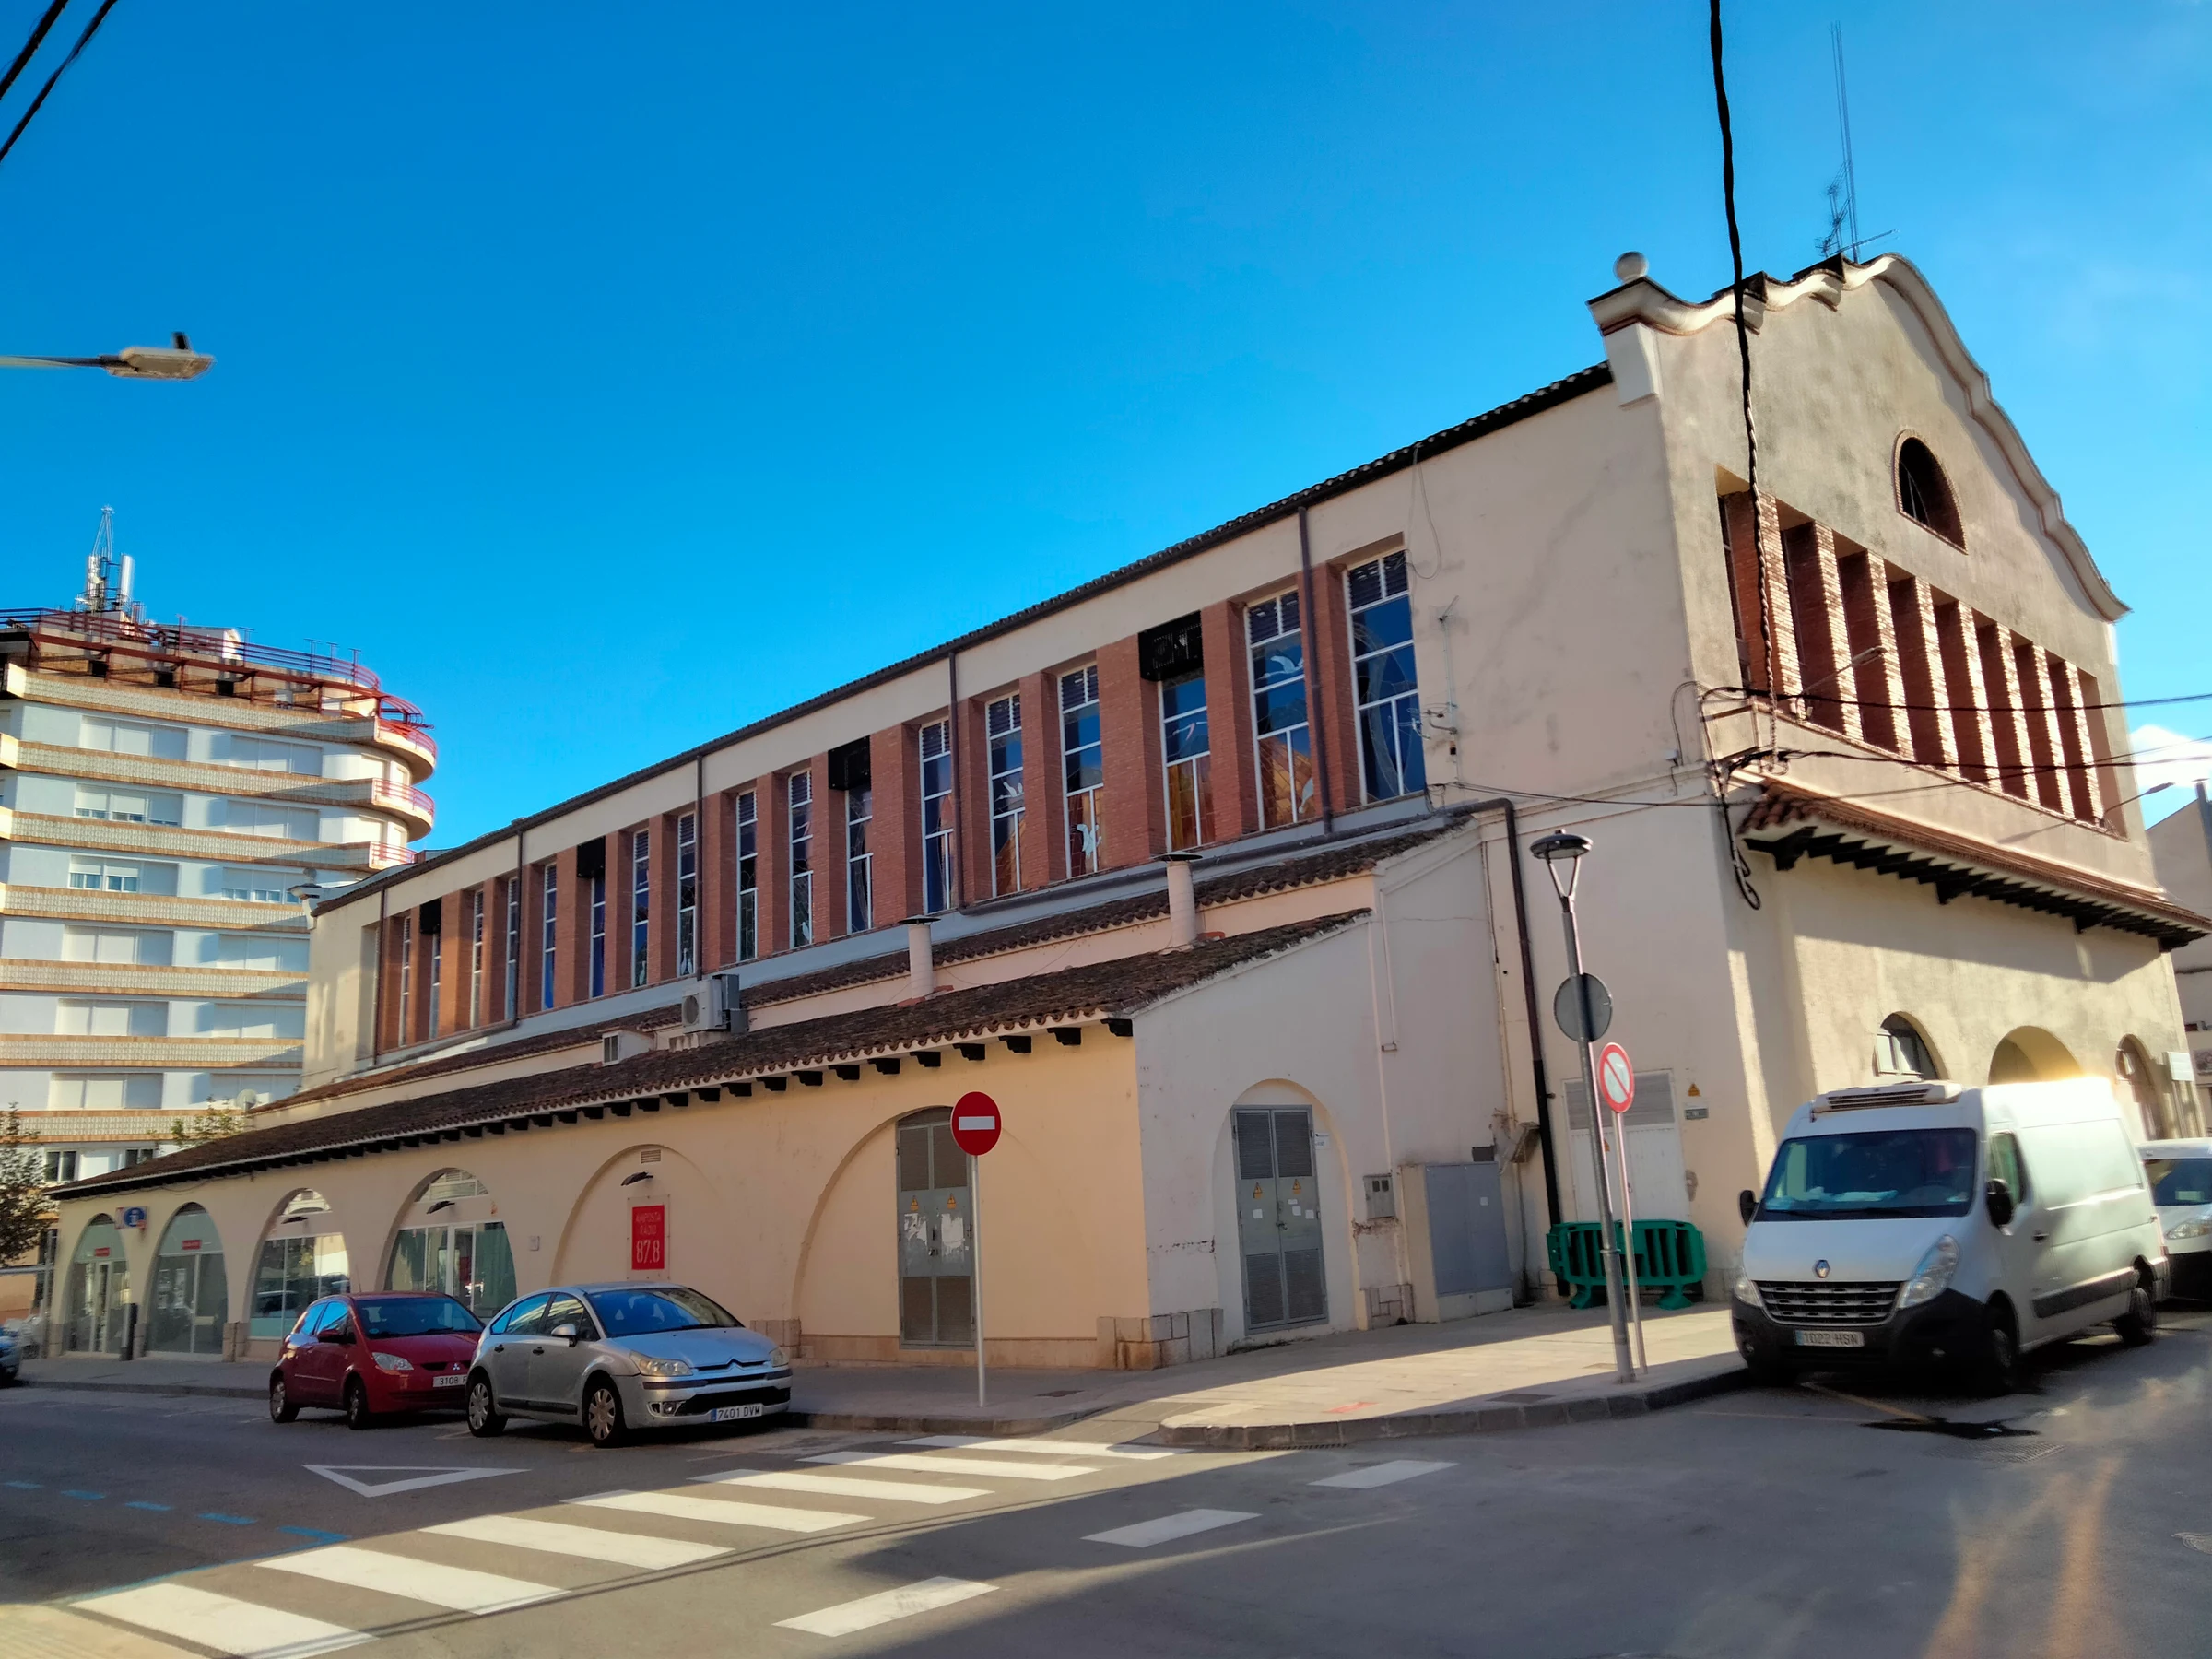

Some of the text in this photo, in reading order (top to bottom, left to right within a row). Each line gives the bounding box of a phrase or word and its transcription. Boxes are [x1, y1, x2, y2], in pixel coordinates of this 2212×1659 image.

[636, 1240, 660, 1264] 87.8
[718, 1406, 760, 1419] 7401 DVM
